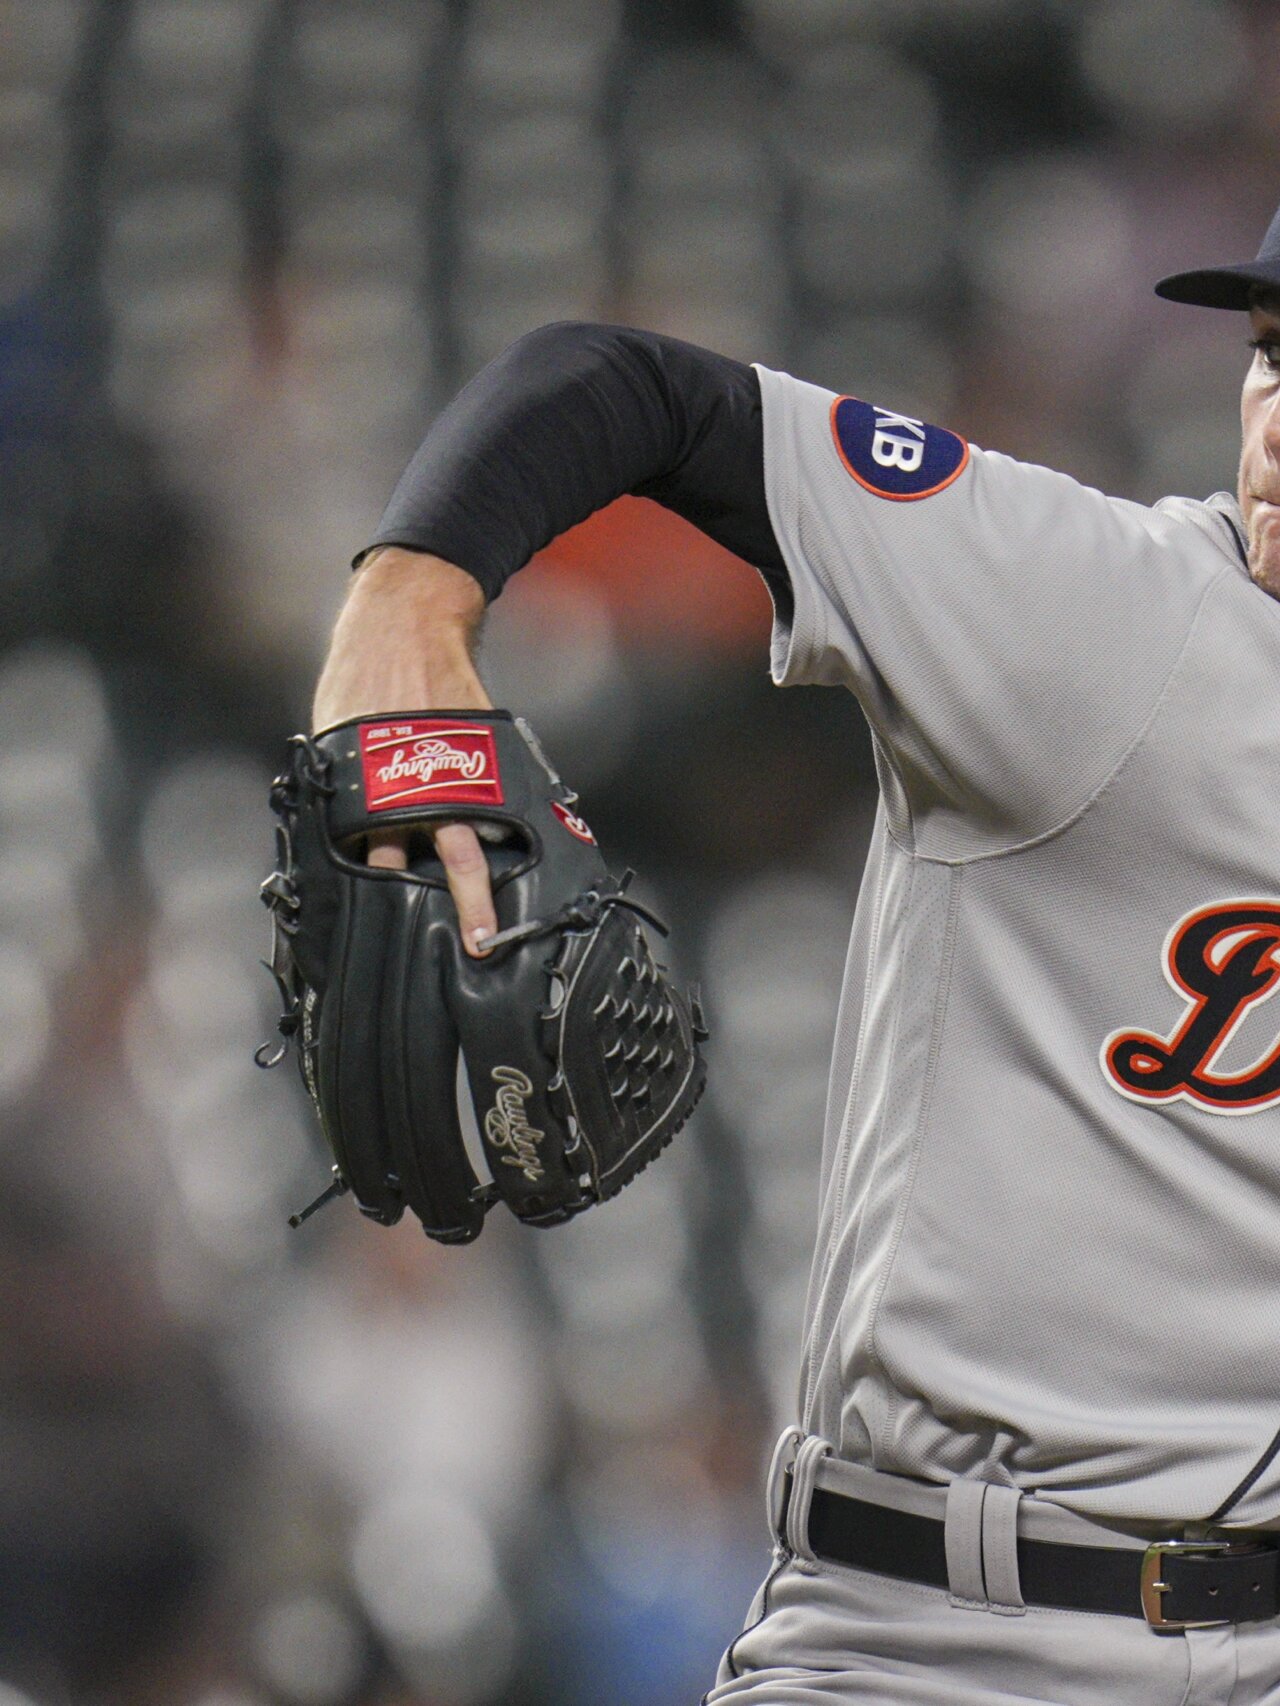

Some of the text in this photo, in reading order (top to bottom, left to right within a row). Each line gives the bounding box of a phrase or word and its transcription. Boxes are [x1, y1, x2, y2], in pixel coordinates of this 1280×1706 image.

[871, 406, 926, 472] KB
[376, 749, 487, 783] Rawlings
[491, 1065, 546, 1181] Rawlings
